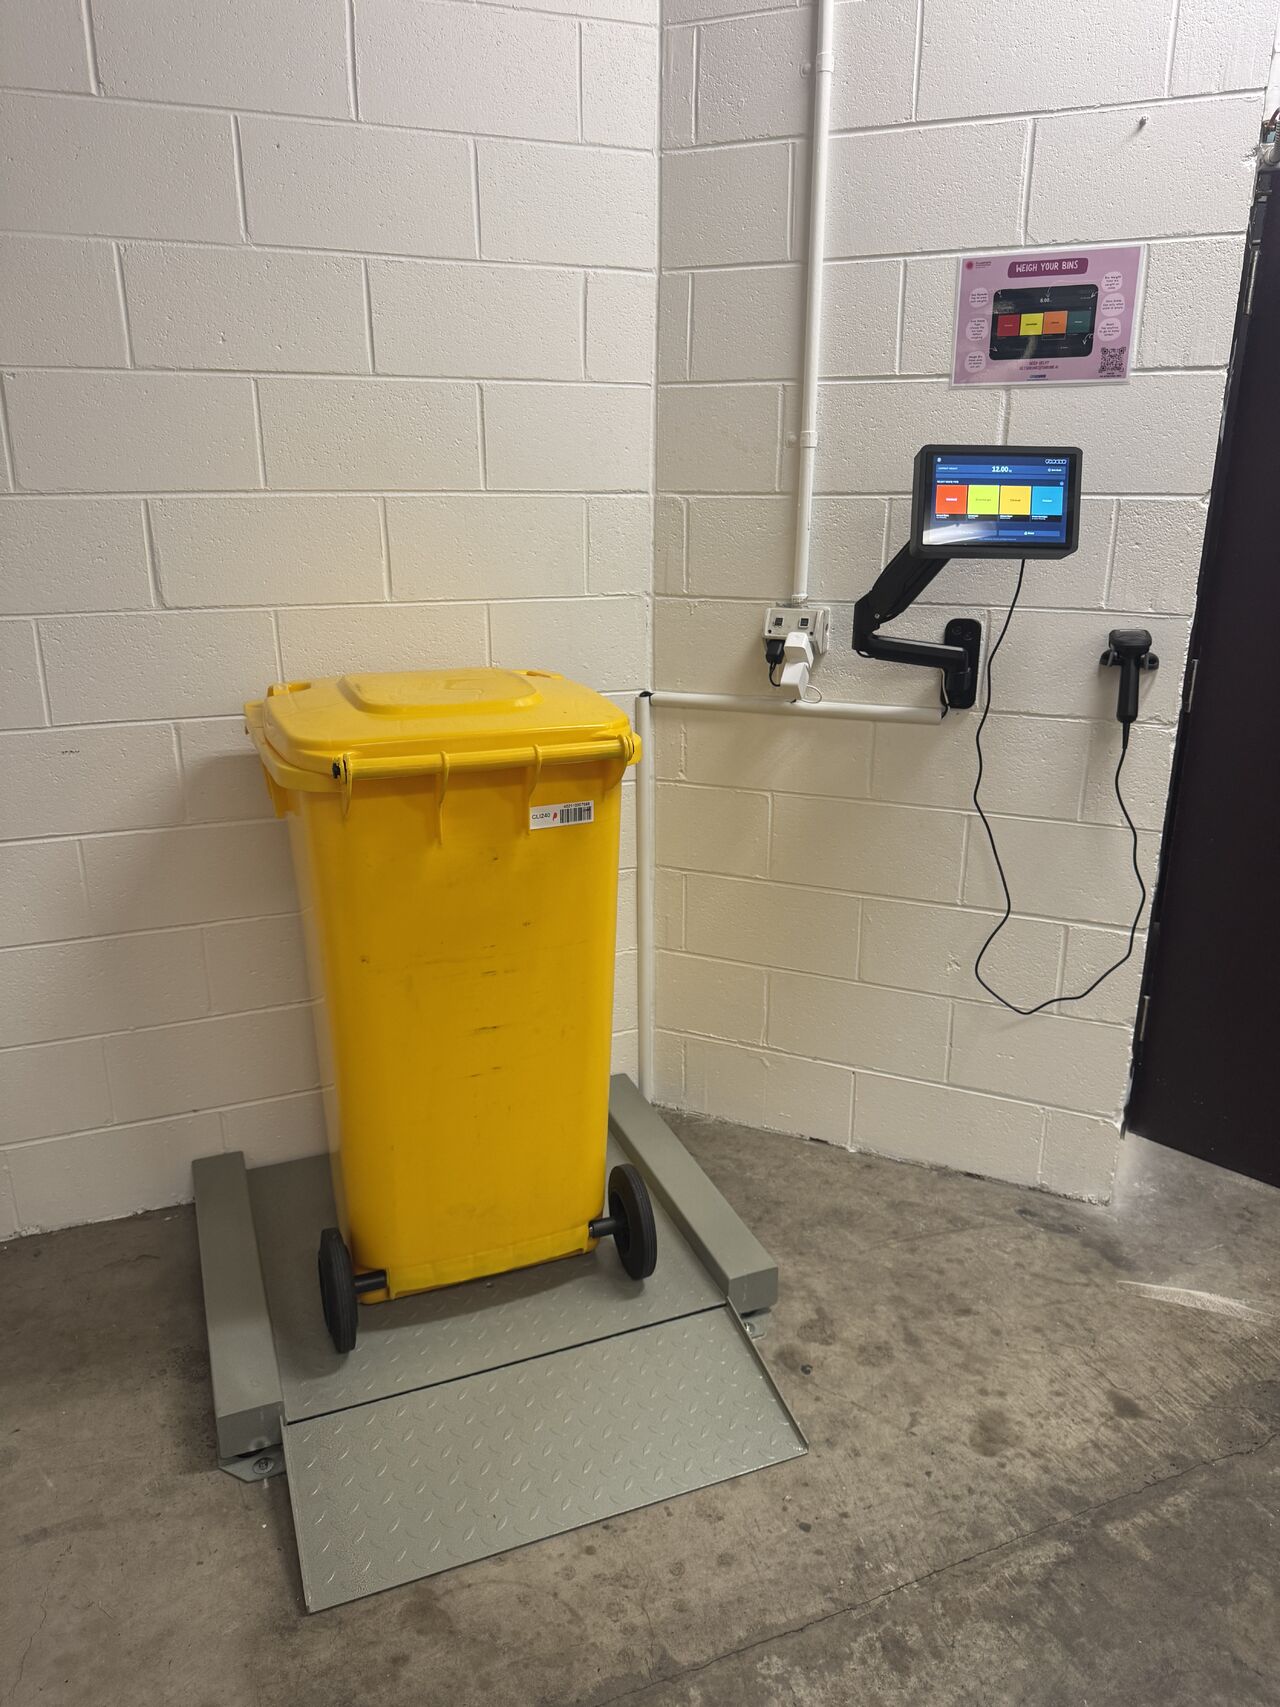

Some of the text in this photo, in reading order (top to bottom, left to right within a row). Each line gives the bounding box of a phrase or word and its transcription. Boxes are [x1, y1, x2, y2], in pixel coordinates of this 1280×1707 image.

[1016, 260, 1079, 273] WEIGH YOUR BINS
